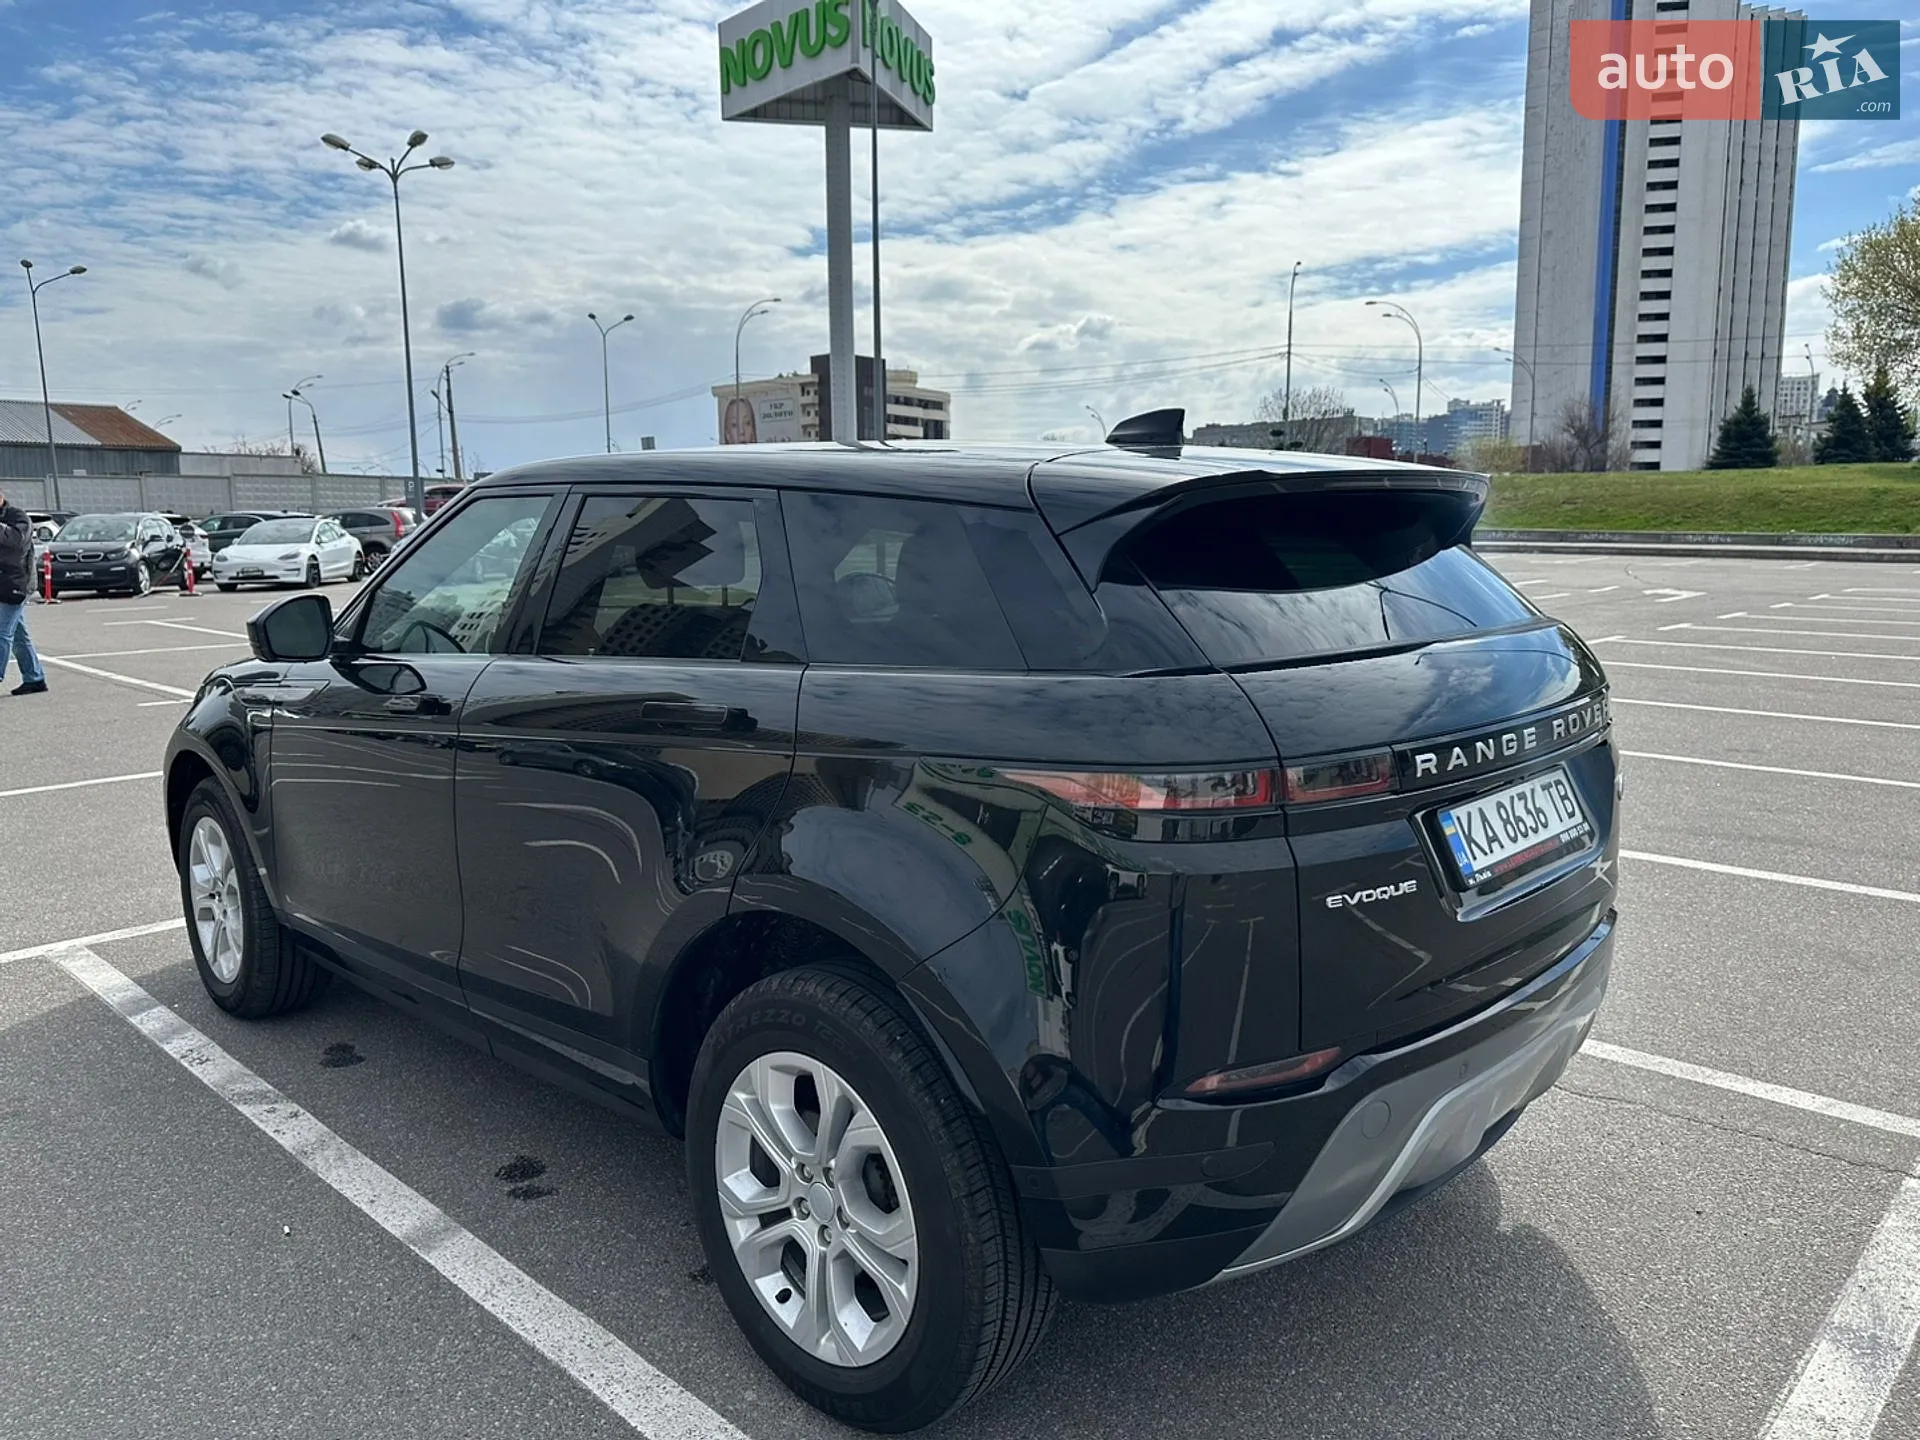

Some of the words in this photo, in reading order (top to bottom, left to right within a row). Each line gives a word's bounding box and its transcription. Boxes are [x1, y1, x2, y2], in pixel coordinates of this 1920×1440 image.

[720, 0, 850, 95] NOVUS
[1415, 727, 1537, 778] RANGE
[1456, 807, 1504, 860] KA
[1499, 794, 1549, 845] 8636
[1541, 778, 1577, 824] TB
[1325, 879, 1418, 909] EVOQUE
